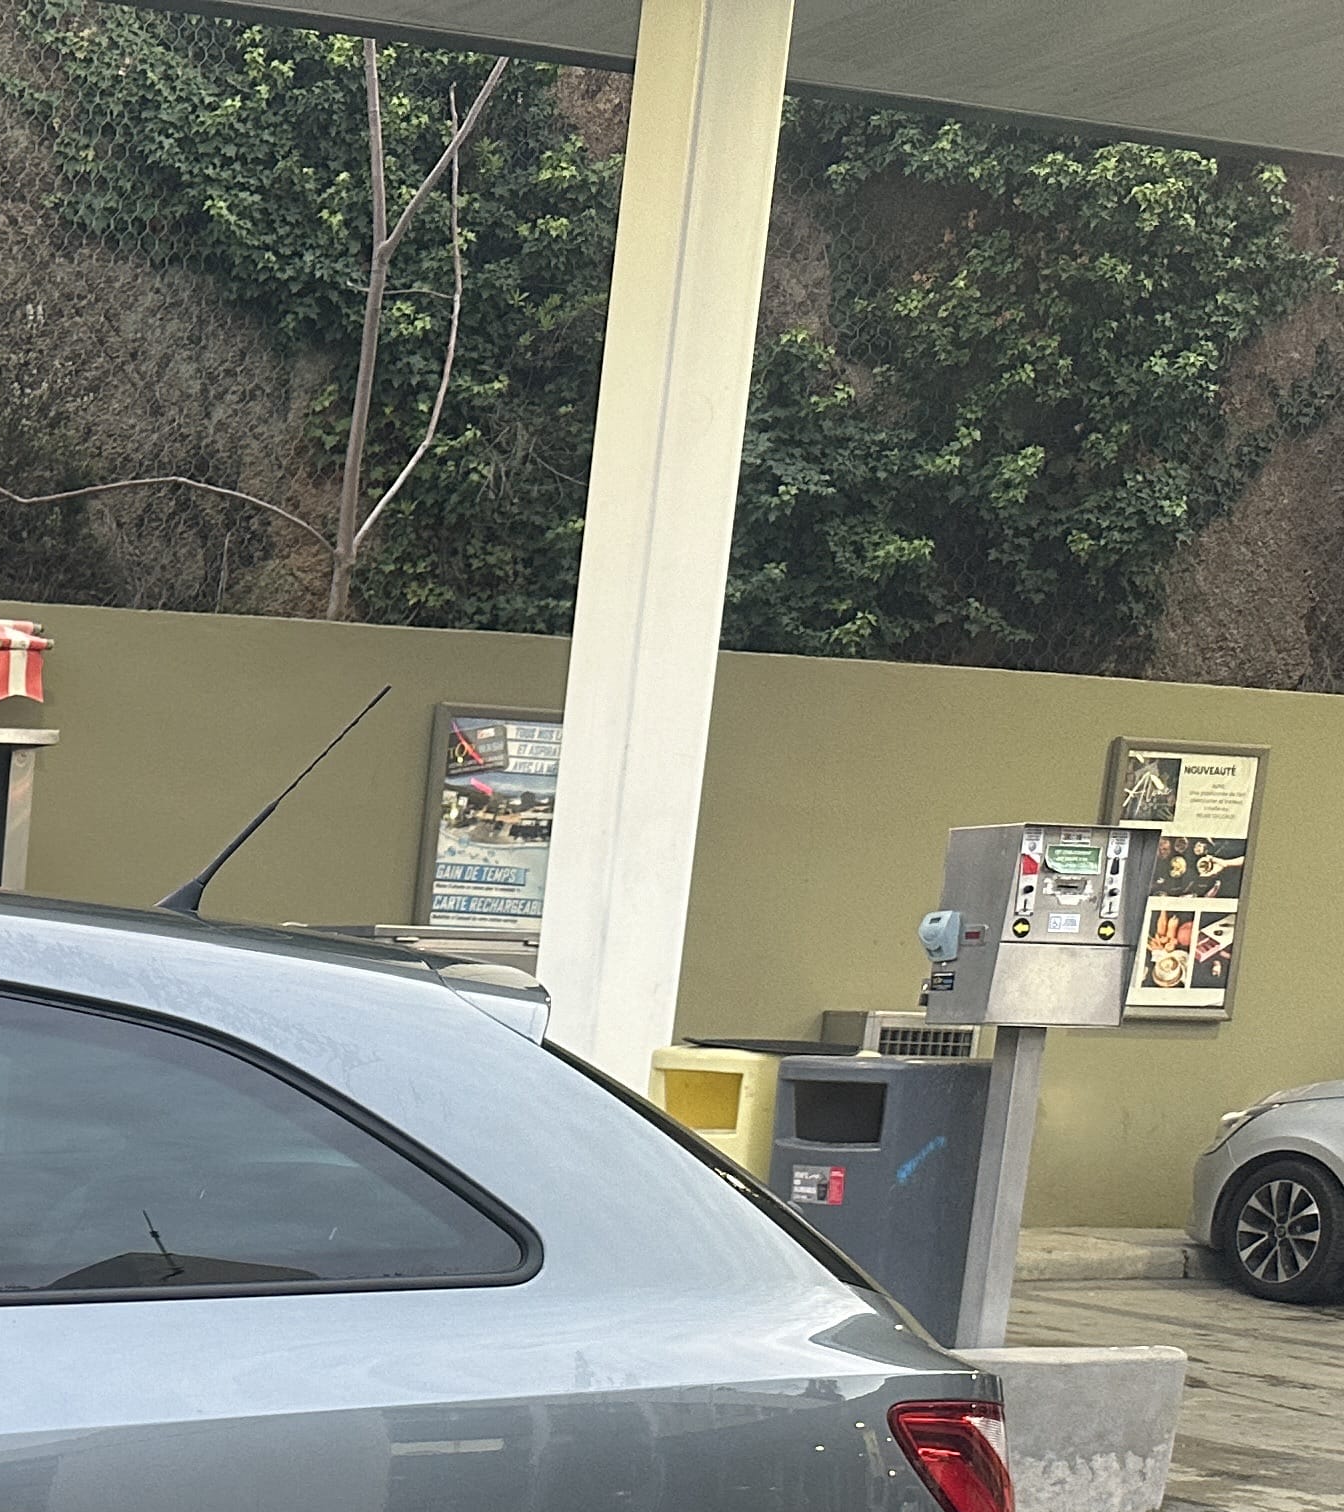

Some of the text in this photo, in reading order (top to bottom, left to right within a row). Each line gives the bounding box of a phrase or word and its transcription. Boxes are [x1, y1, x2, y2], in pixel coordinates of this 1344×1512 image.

[1183, 764, 1237, 777] NOUVEAUTÉ
[435, 864, 517, 882] GAIN DE TEMPS
[432, 895, 543, 915] CARTE RECHARGEABL
